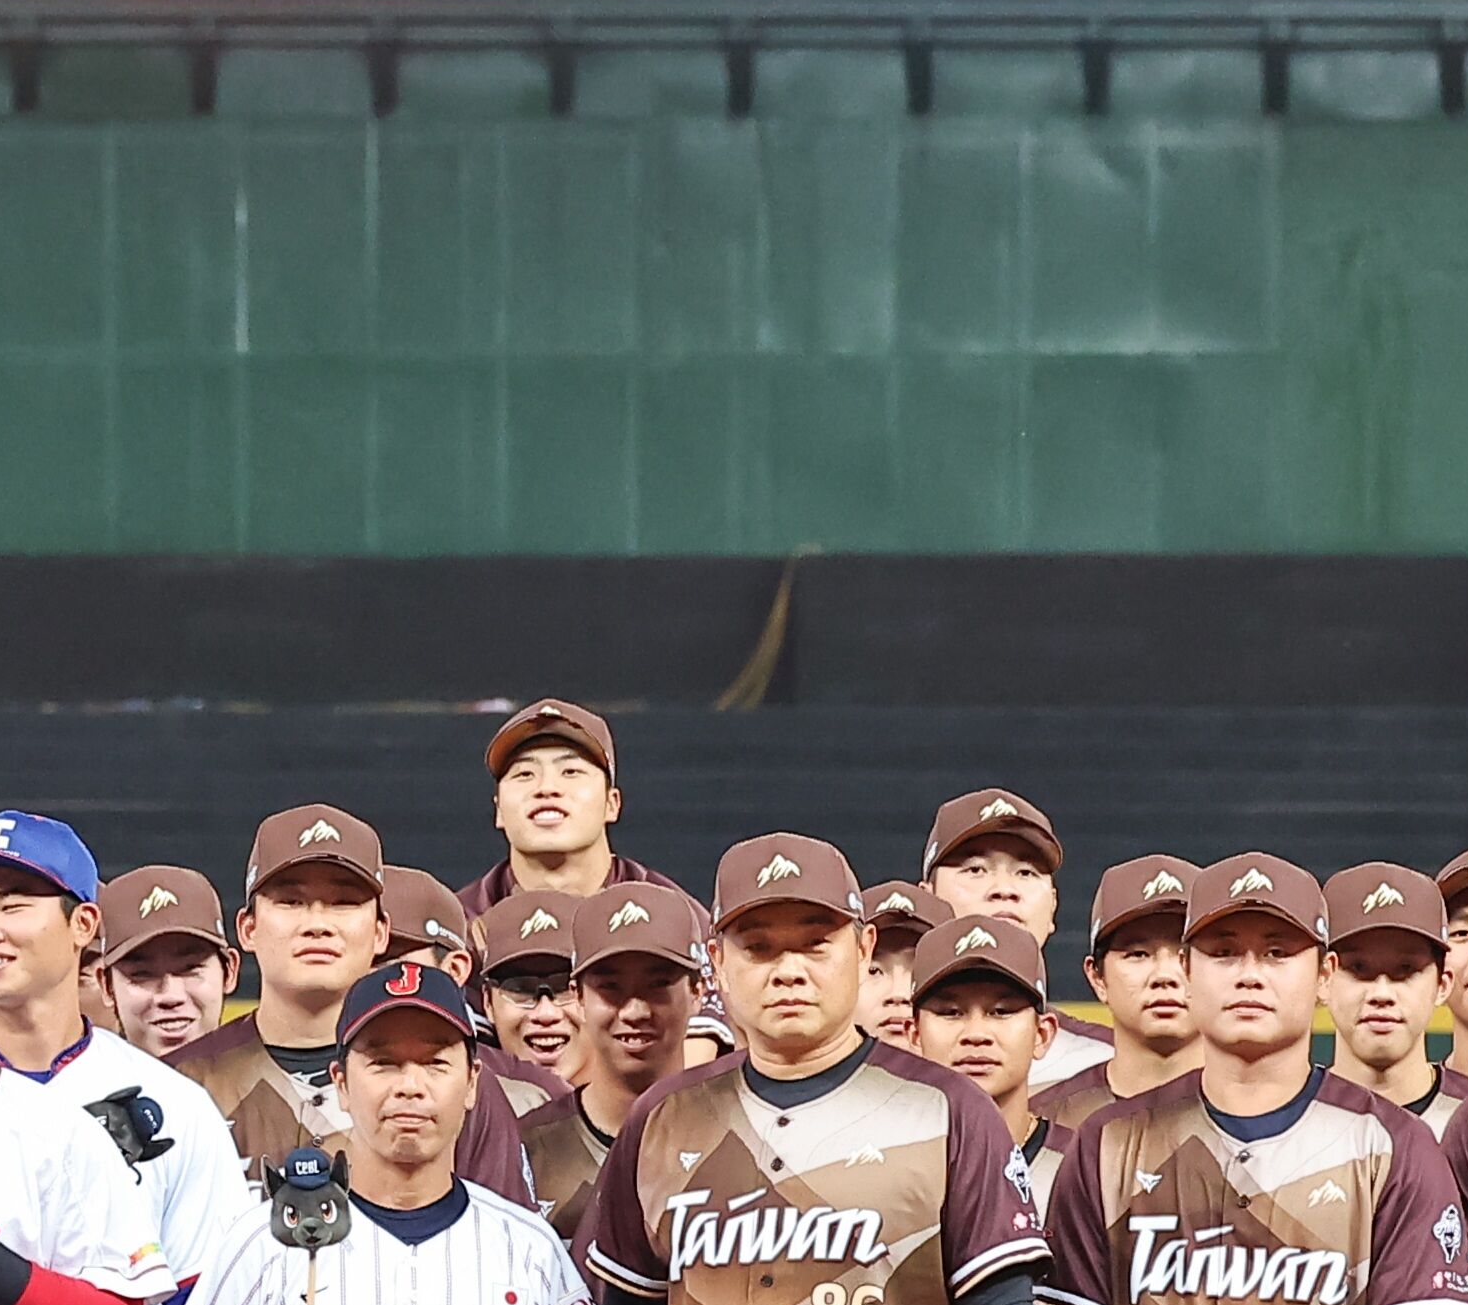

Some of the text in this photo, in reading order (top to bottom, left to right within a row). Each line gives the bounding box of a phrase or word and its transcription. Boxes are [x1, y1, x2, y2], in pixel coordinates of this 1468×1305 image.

[385, 963, 422, 996] J
[295, 1159, 321, 1176] CPBL
[665, 1188, 888, 1284] Taiwan
